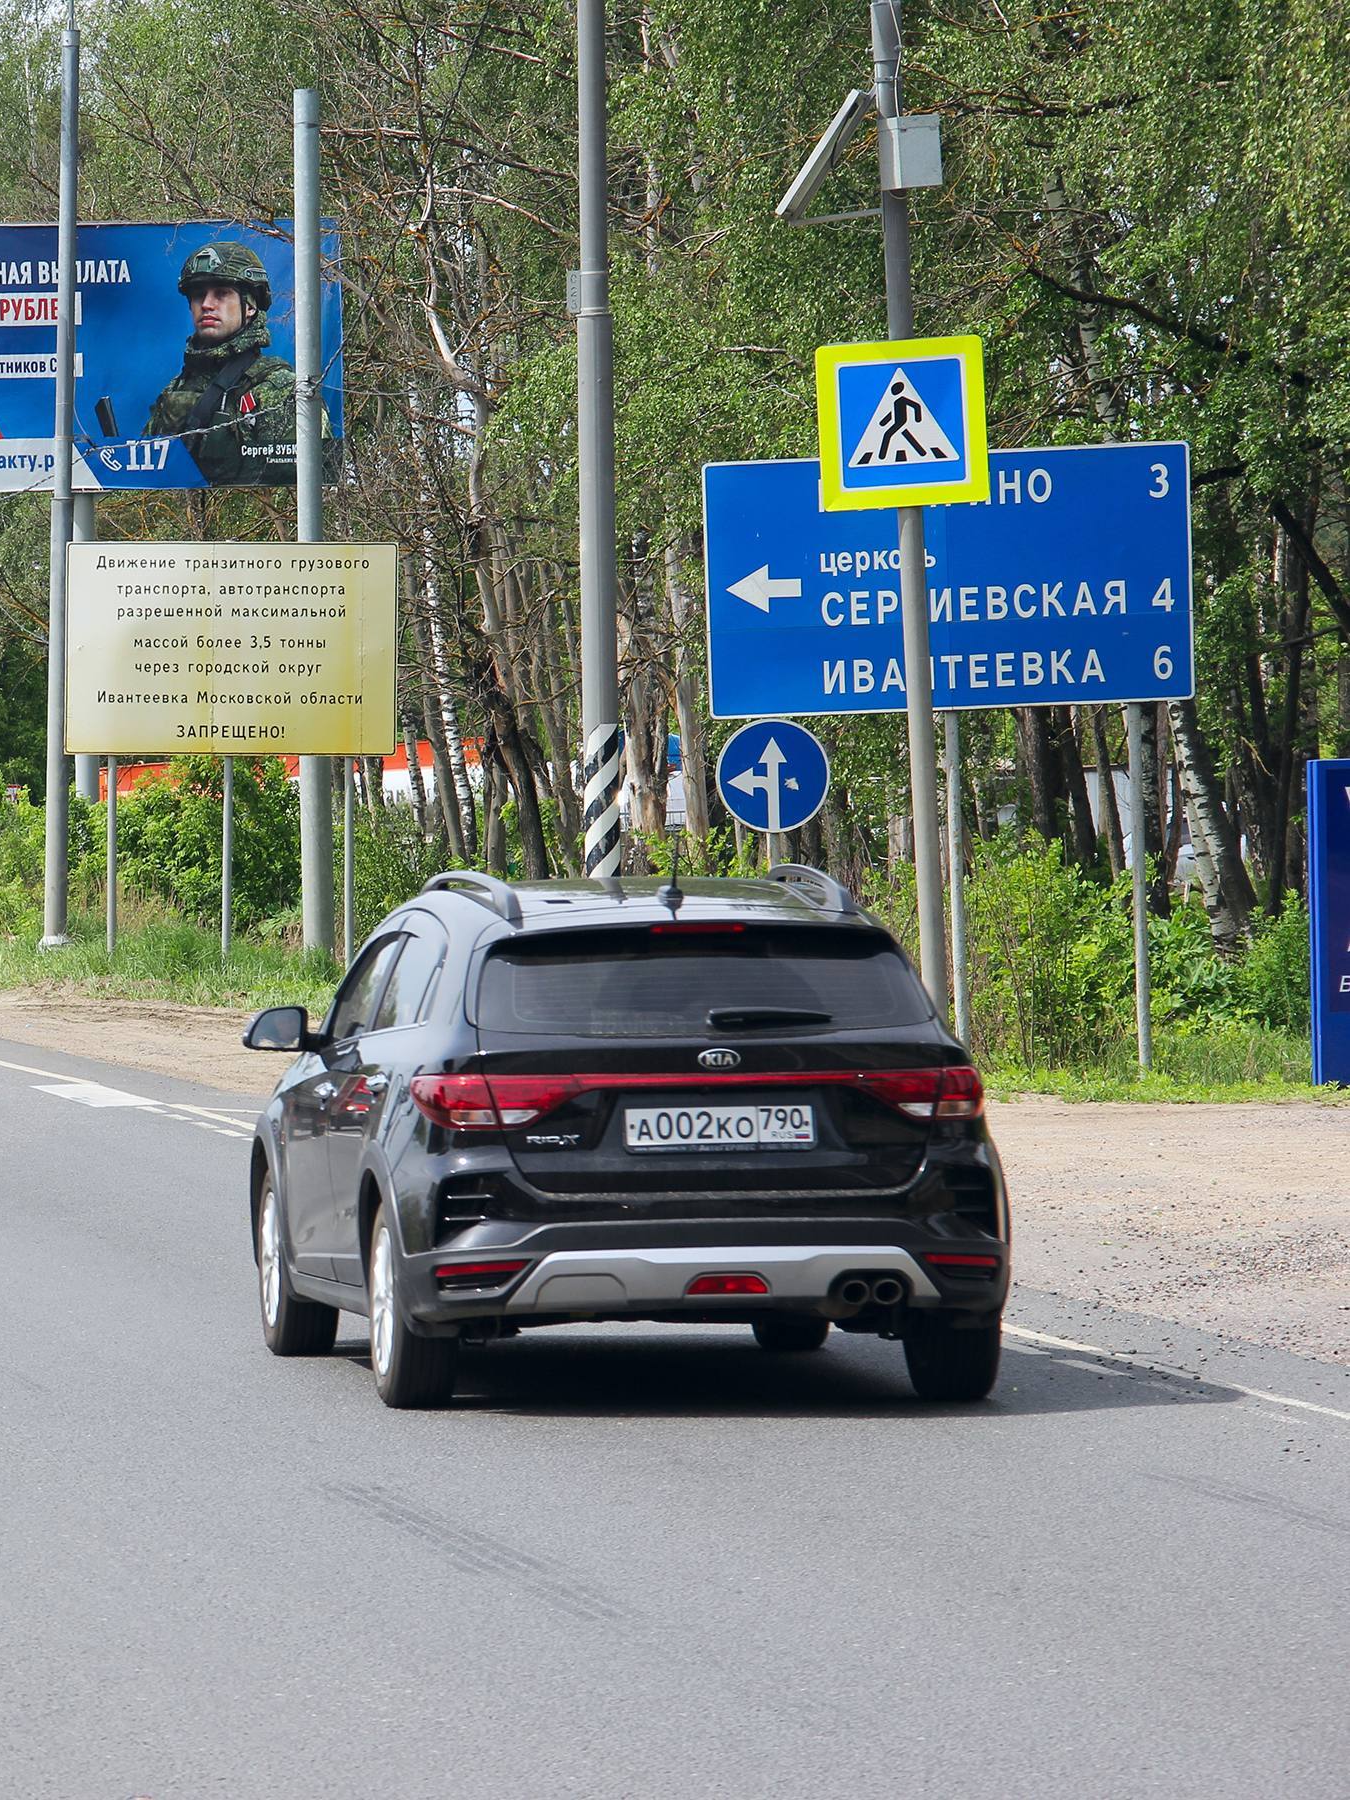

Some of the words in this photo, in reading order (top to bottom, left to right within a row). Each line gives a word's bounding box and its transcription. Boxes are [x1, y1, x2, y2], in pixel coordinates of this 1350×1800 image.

[38, 260, 130, 284] ВЛАТА
[0, 297, 58, 321] РУБЛЕ
[126, 439, 170, 471] 117
[241, 444, 274, 457] Сергей
[275, 444, 298, 455] ЗУБК
[1149, 464, 1169, 498] 3
[96, 556, 176, 570] Движение
[185, 557, 282, 572] транзитного
[291, 557, 370, 572] грузового
[820, 548, 936, 577] церкоь
[117, 584, 211, 598] транспорта,
[219, 583, 346, 597] автотранспорта
[821, 580, 1127, 627] СЕРИЕВСКАЯ
[1152, 578, 1175, 612] 4
[117, 604, 222, 620] разрешенной
[231, 605, 346, 618] максимальной
[134, 635, 188, 648] массой
[196, 635, 242, 649] более
[250, 635, 271, 649] 3,5
[280, 636, 326, 648] тонны
[134, 662, 179, 676] через
[188, 660, 270, 675] городской
[278, 662, 322, 677] округ
[823, 649, 1106, 695] ИВАТЕЕВКА
[1153, 646, 1173, 680] 6
[97, 690, 188, 704] Ивантеевка
[196, 691, 291, 704] Московской
[300, 692, 363, 705] области
[176, 725, 285, 740] ЗАПРЕЩЕНО!
[705, 1053, 734, 1066] KIA
[760, 1108, 803, 1130] 790
